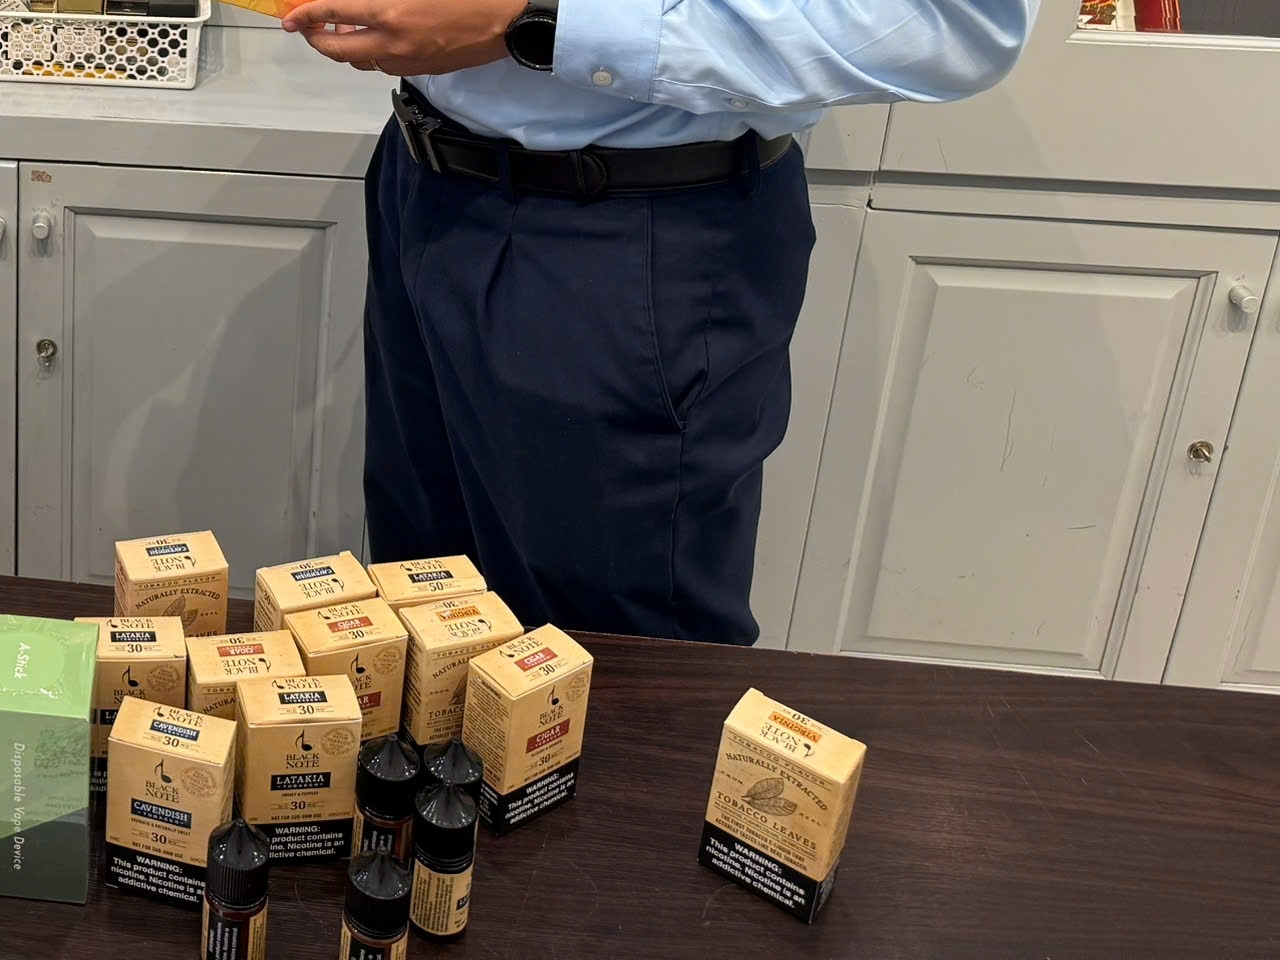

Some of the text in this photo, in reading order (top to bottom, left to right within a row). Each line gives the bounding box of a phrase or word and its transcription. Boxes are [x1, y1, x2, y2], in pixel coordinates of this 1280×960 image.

[429, 582, 444, 591] 50
[136, 588, 220, 609] NATURALLY EXTRACTED
[349, 630, 364, 639] 30
[127, 644, 142, 652] 30
[524, 652, 545, 664] CIGAR
[539, 664, 555, 676] 30
[298, 705, 314, 714] 30
[792, 713, 810, 725] 30
[153, 721, 196, 737] CAVENDISH
[536, 725, 560, 742] CIGAR
[762, 723, 797, 745] NOTE
[773, 715, 816, 741] VIRGINIA
[163, 736, 179, 747] 30
[760, 730, 796, 752] BLACK
[286, 753, 319, 761] BLACK
[286, 760, 319, 769] NOTE
[539, 754, 551, 766] 30
[733, 736, 825, 785] TOBACCO FLAVOR
[145, 781, 179, 794] BLACK
[276, 774, 324, 784] LATAKIA
[526, 773, 560, 793] WARNING:
[726, 752, 827, 811] NATURALLY EXTRACTED
[145, 788, 179, 803] NOTE
[508, 772, 574, 810] This product contains
[13, 743, 25, 870] Disposable Vape Device
[134, 801, 187, 821] CAVENDISH
[290, 801, 306, 810] 30
[505, 803, 532, 819] nicotine.
[534, 787, 559, 804] Nicotine
[510, 790, 568, 824] addictive chemical.
[717, 791, 817, 850] TOBACCO LEAVES
[151, 832, 167, 844] 30
[272, 832, 343, 843] product contains
[275, 826, 320, 834] WARNING:
[288, 841, 323, 849] Nicotine
[296, 848, 336, 857] chemical.
[136, 855, 182, 873] WARNING:
[710, 838, 805, 895] This product contains
[735, 843, 782, 873] WARNING:
[111, 866, 147, 881] nicotine.
[149, 876, 184, 891] Nicotine
[113, 857, 205, 887] This product contains
[706, 845, 805, 904] nicotine. Nicotine is an
[118, 876, 199, 902] addictive chemical.
[712, 858, 795, 908] addictive chemical.
